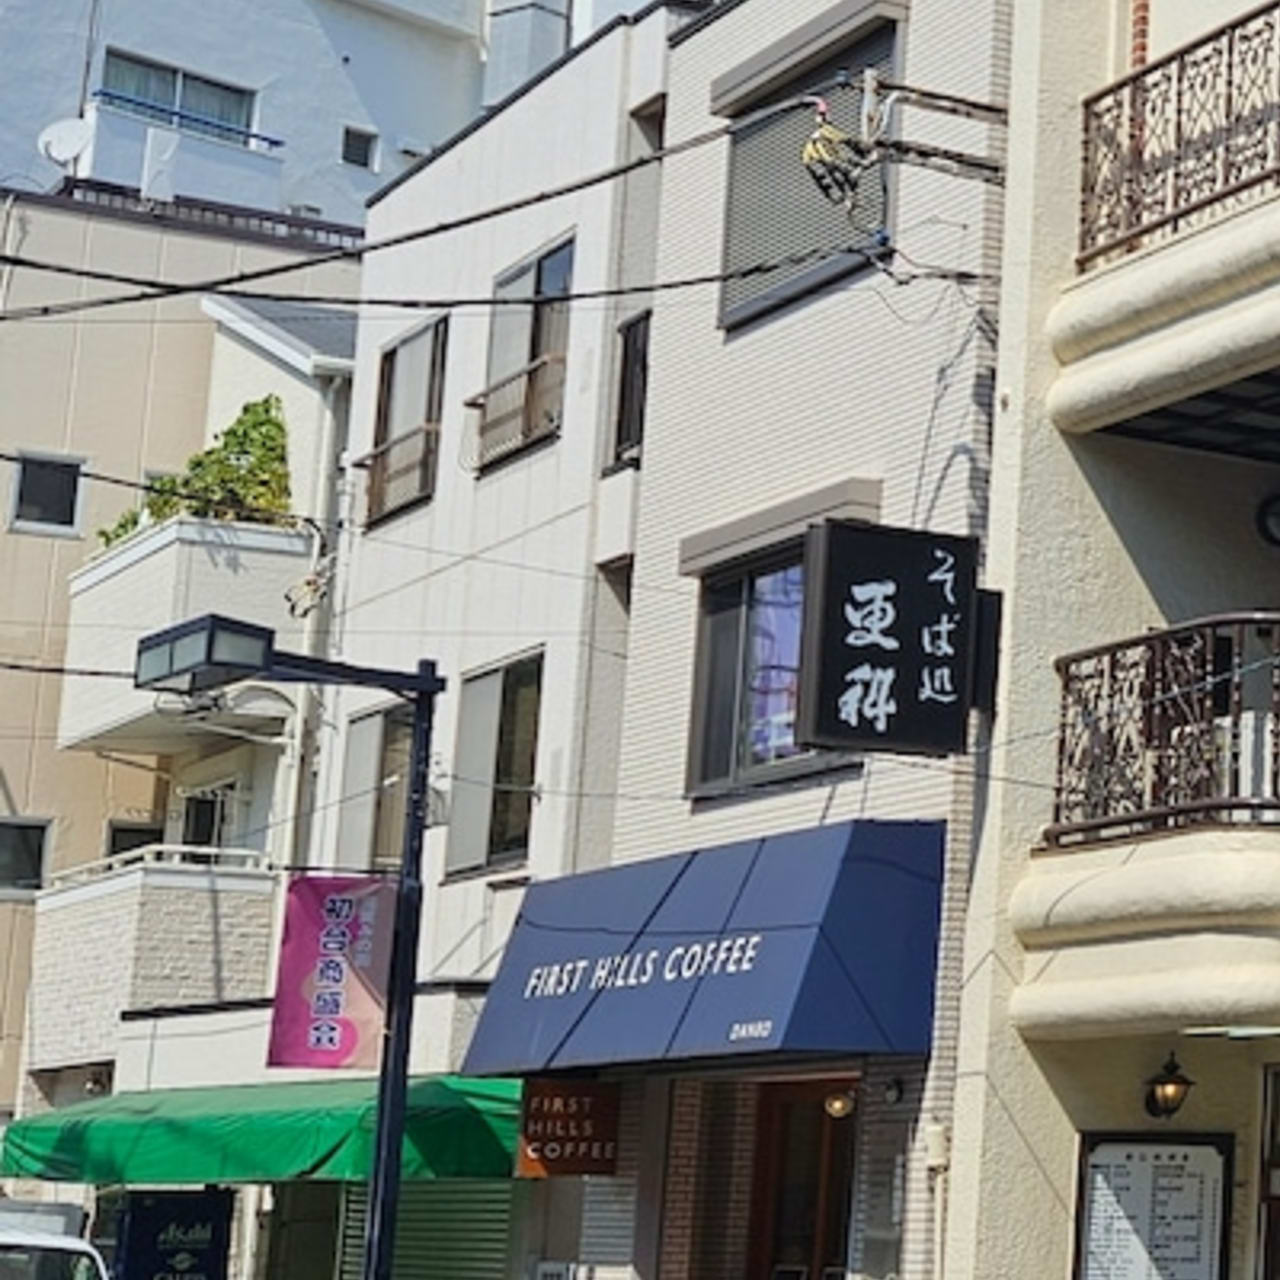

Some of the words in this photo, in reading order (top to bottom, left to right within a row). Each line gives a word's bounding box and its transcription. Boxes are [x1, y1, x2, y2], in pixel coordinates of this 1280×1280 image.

[837, 578, 900, 733] 更科
[524, 958, 588, 999] FIRST
[590, 949, 658, 990] HILLS
[663, 934, 763, 982] COFFEE
[530, 1096, 592, 1114] FIRST
[527, 1119, 593, 1137] HILLS
[525, 1141, 616, 1160] COFFEE
